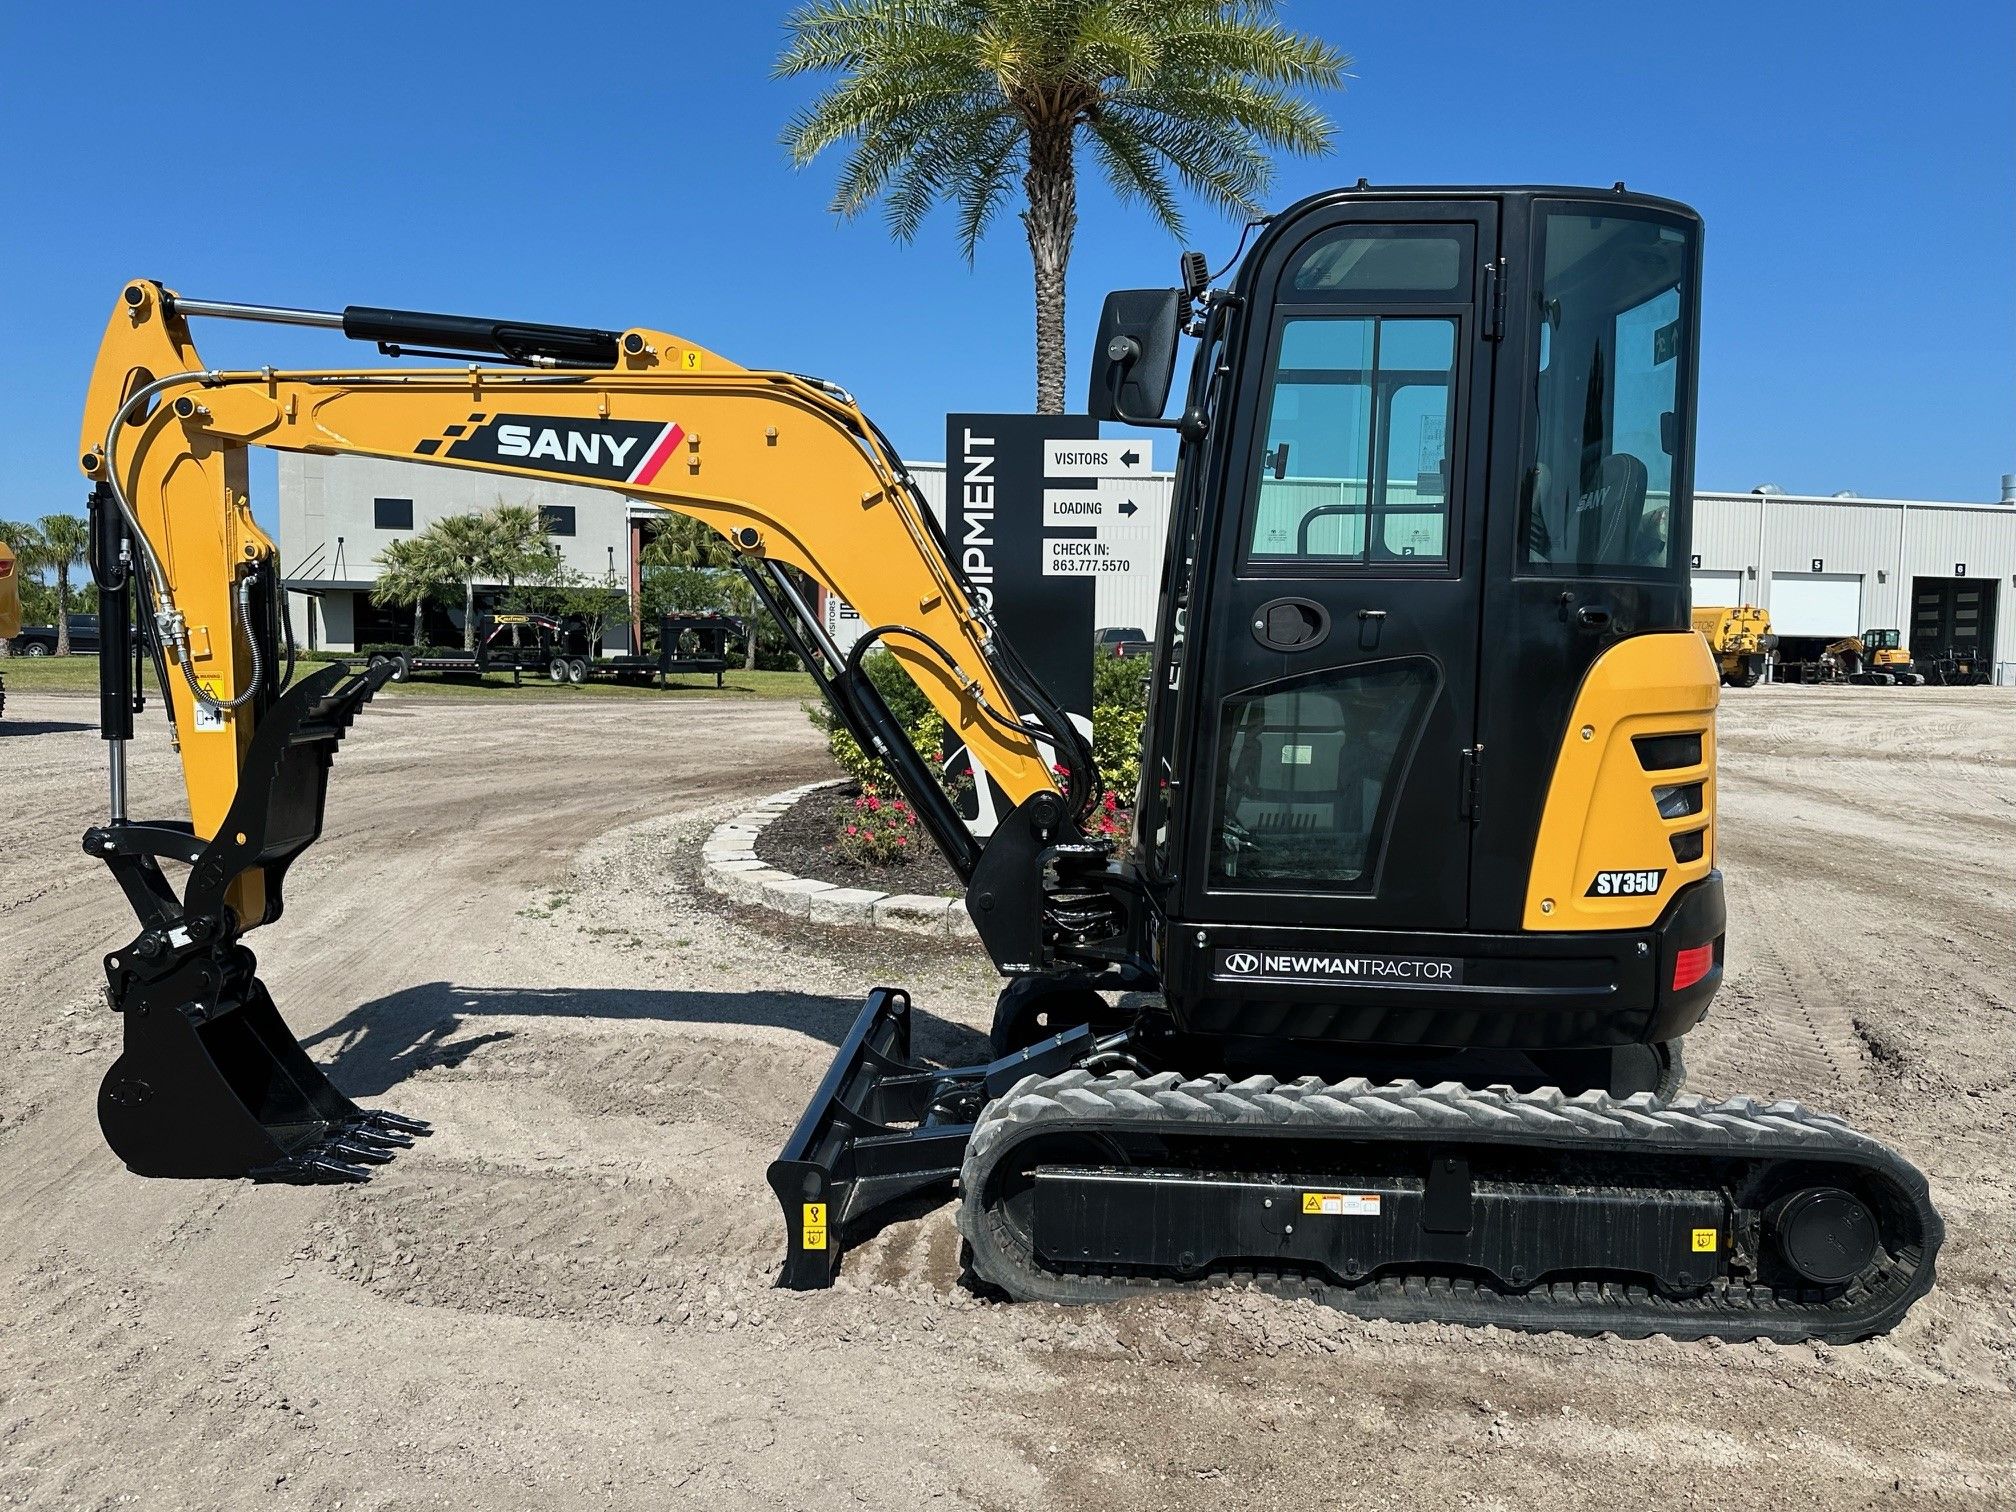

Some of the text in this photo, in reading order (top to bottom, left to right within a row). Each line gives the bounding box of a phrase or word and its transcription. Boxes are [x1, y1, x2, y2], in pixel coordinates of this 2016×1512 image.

[497, 424, 638, 467] SANY
[1055, 453, 1108, 465] VISITORS
[1053, 502, 1102, 514] LOADING
[1053, 543, 1110, 556] CHECK IN:
[1052, 559, 1130, 572] 863.777.5570
[1692, 556, 1699, 565] 4
[1814, 560, 1821, 569] 5
[1957, 565, 1963, 573] 6
[1597, 872, 1659, 894] SY35U
[1265, 956, 1453, 979] NEWMANTRACTOR
